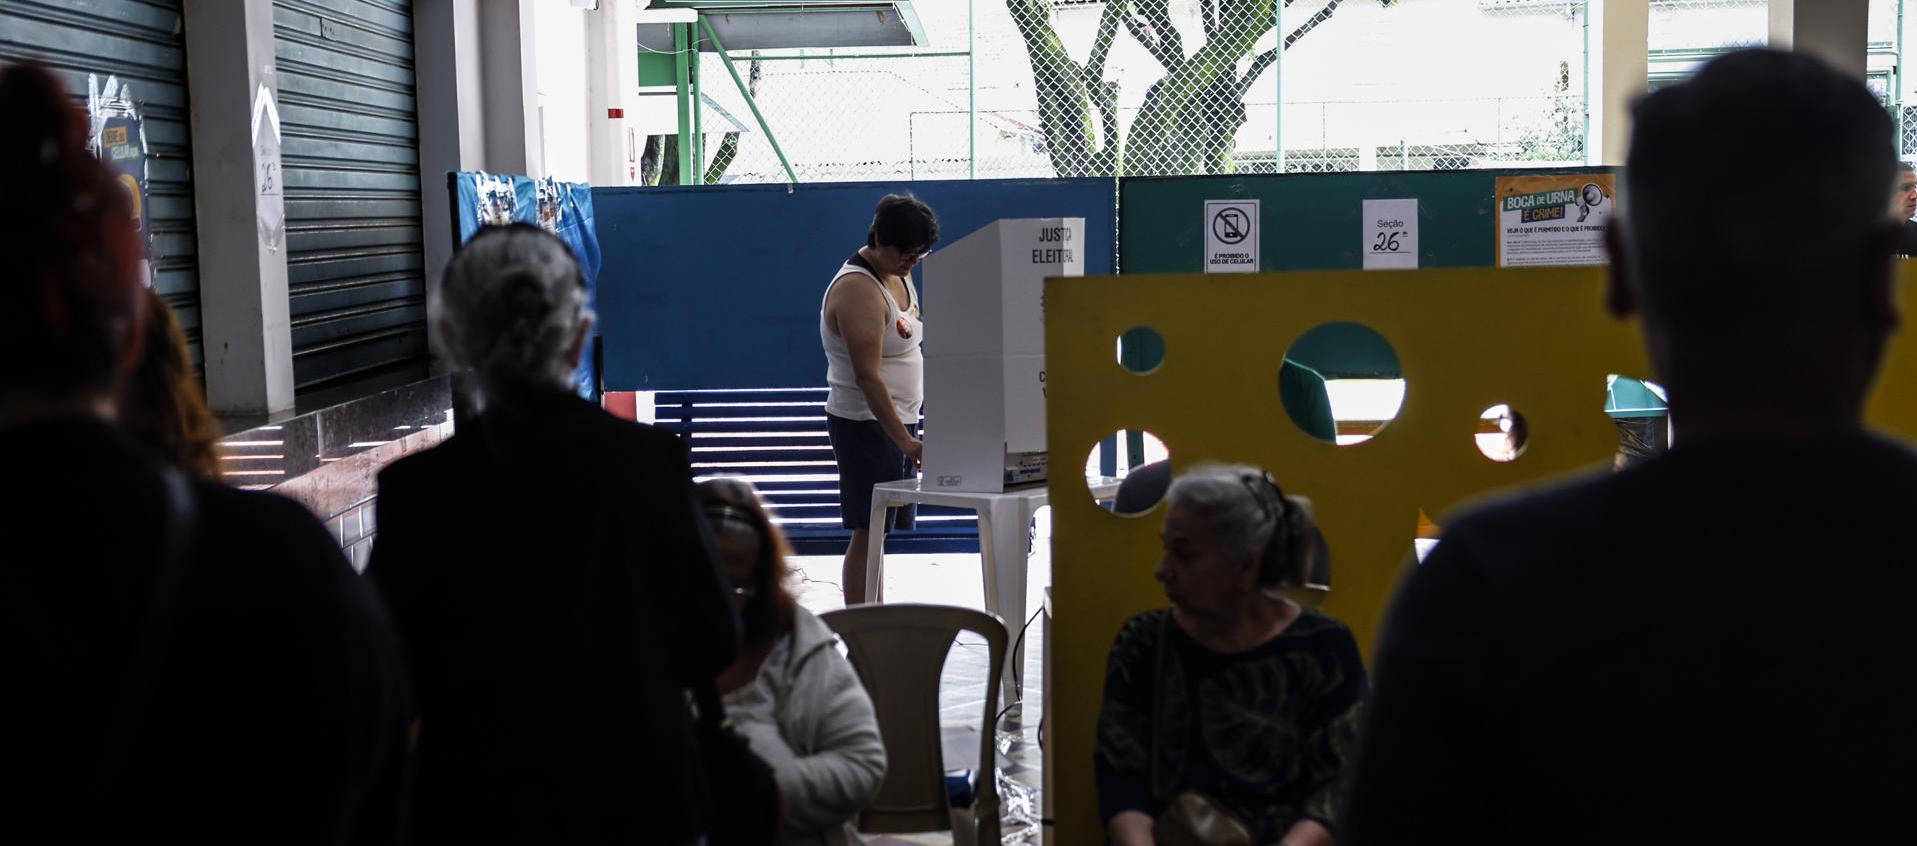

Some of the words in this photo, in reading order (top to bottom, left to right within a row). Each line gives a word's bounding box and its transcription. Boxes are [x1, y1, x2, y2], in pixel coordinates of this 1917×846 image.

[1507, 195, 1535, 209] BOCA
[1536, 196, 1545, 204] DE
[1546, 190, 1575, 204] URNA
[1524, 208, 1530, 221] É
[1532, 206, 1563, 220] CRIME!
[1377, 219, 1404, 229] Seção
